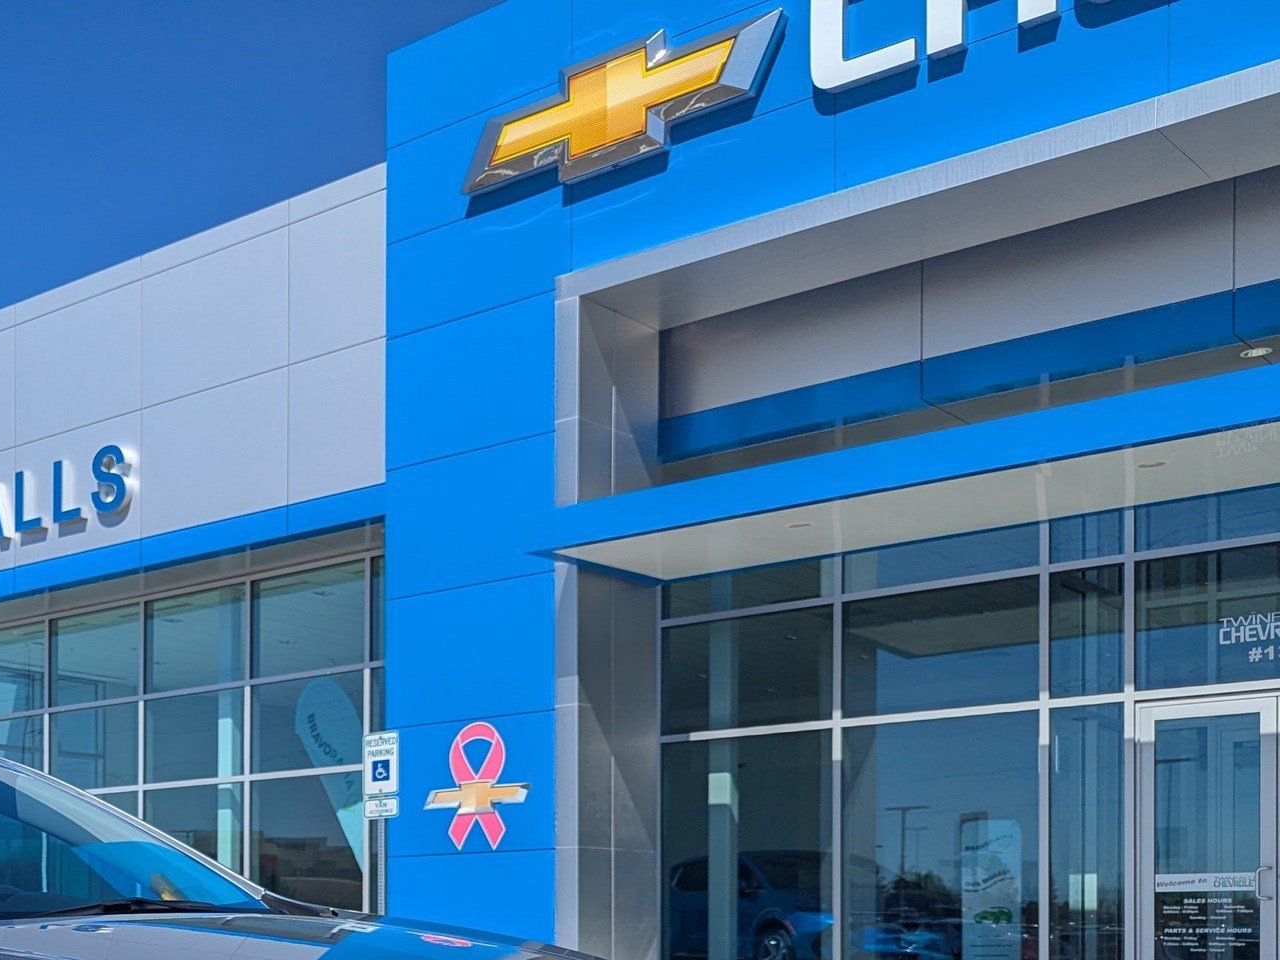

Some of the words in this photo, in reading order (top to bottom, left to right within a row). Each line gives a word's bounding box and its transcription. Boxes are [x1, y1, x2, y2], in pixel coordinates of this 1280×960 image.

[365, 737, 397, 748] RESERVED
[367, 748, 394, 758] PARKING
[1156, 880, 1196, 888] Welcome
